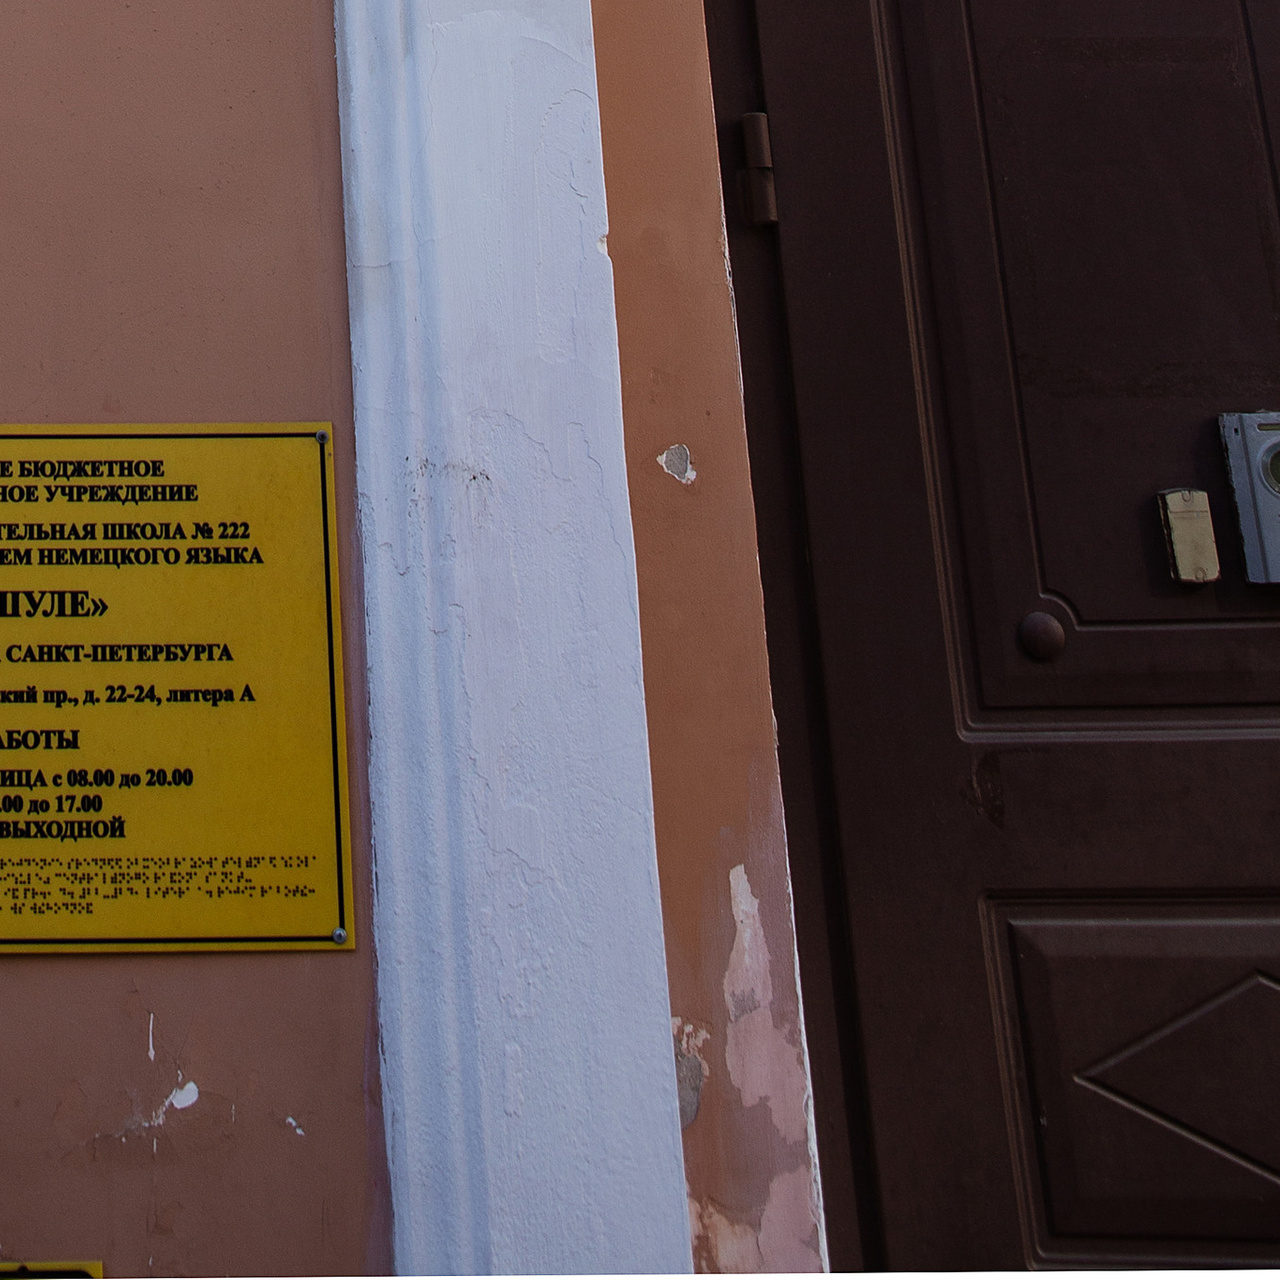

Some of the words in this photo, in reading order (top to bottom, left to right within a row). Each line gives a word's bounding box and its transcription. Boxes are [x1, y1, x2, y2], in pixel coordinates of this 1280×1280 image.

[17, 459, 165, 483] БЮДЖЕТНОЕ
[42, 483, 199, 506] УЧРЕЖДЕНИЕ
[101, 522, 188, 541] ШКОЛА
[190, 521, 215, 541] №
[217, 521, 251, 541] 222
[36, 547, 181, 570] НЕМЕЦКОГО
[184, 546, 265, 566] ЯЗЫКА
[5, 642, 235, 664] САНКТ-ПЕТЕРБУРГА
[42, 689, 80, 710] пр.,
[82, 688, 101, 706] д.
[104, 684, 163, 708] 22-24,
[165, 688, 236, 709] литера
[238, 683, 257, 703] А
[51, 773, 64, 789] с
[66, 768, 116, 789] 08.00
[117, 772, 142, 791] до
[144, 767, 195, 788] 20.00
[26, 798, 51, 816] до
[54, 793, 104, 814] 17.00
